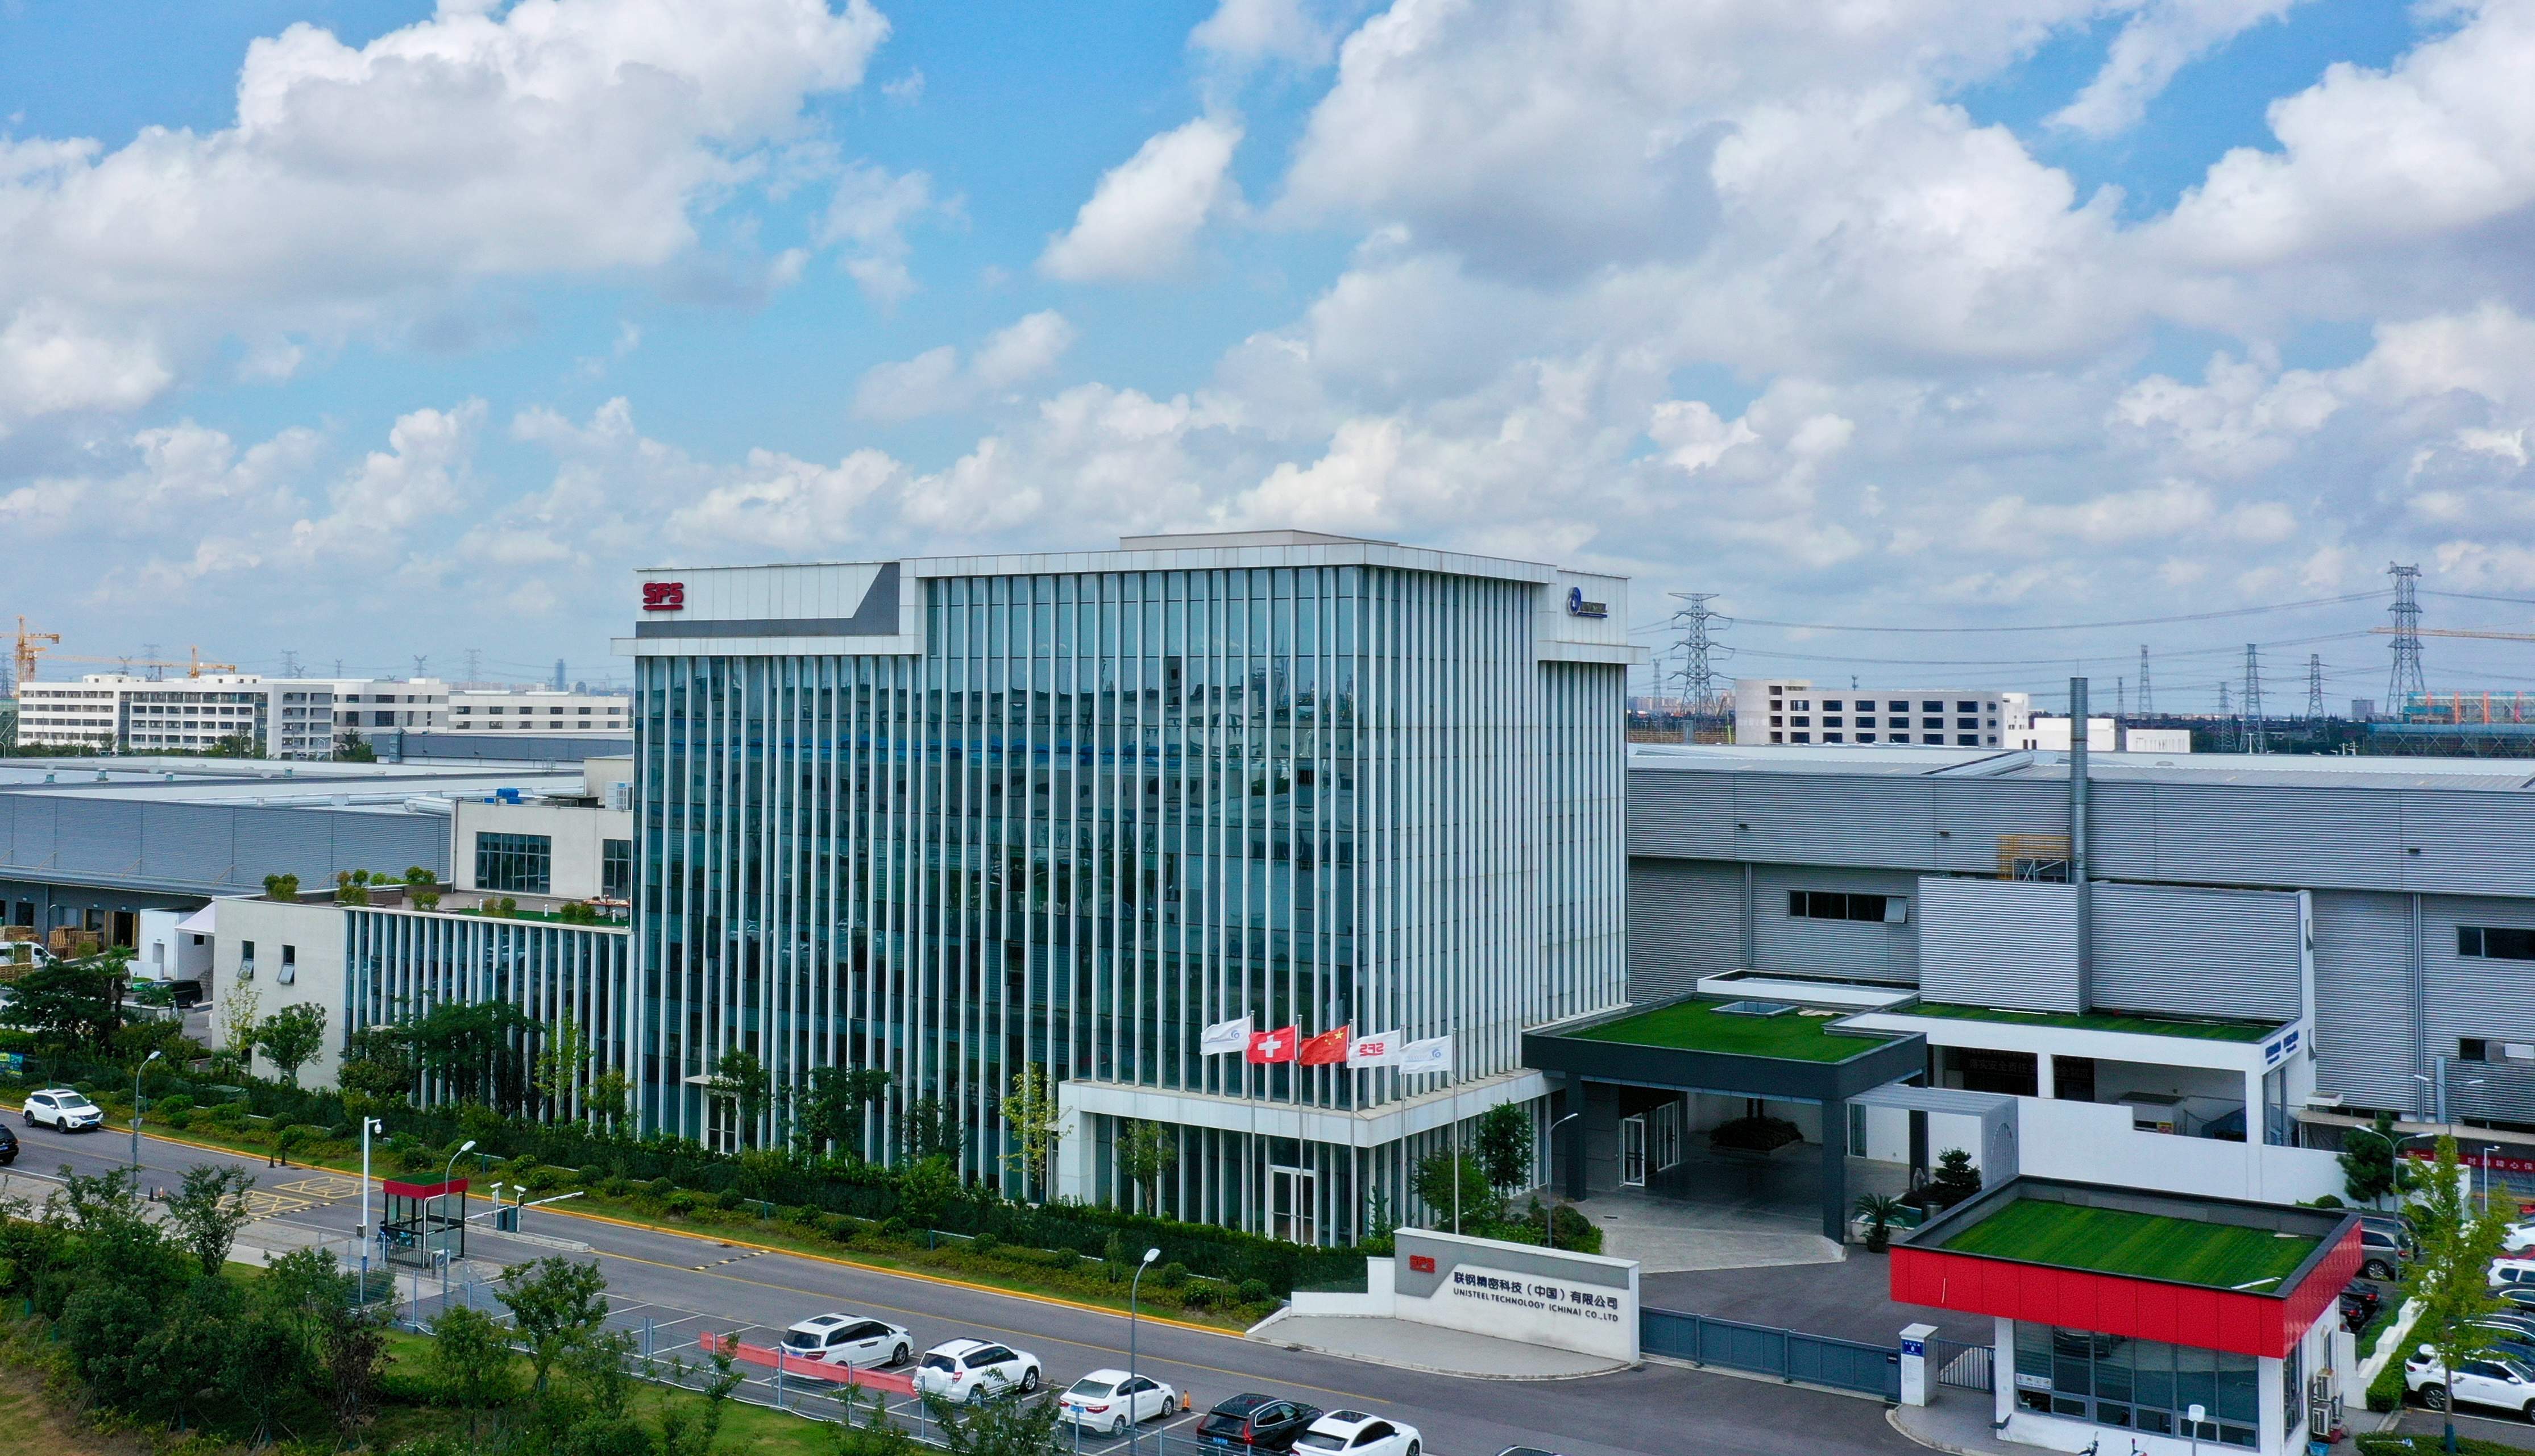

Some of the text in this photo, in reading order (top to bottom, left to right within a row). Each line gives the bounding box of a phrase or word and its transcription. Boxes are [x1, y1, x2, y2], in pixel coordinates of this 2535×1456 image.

[643, 582, 684, 604] SFS
[1453, 1288, 1490, 1301] UNISTEEL
[1491, 1293, 1545, 1309] TECHNOLOGY
[1549, 1304, 1582, 1316] (CHINA)
